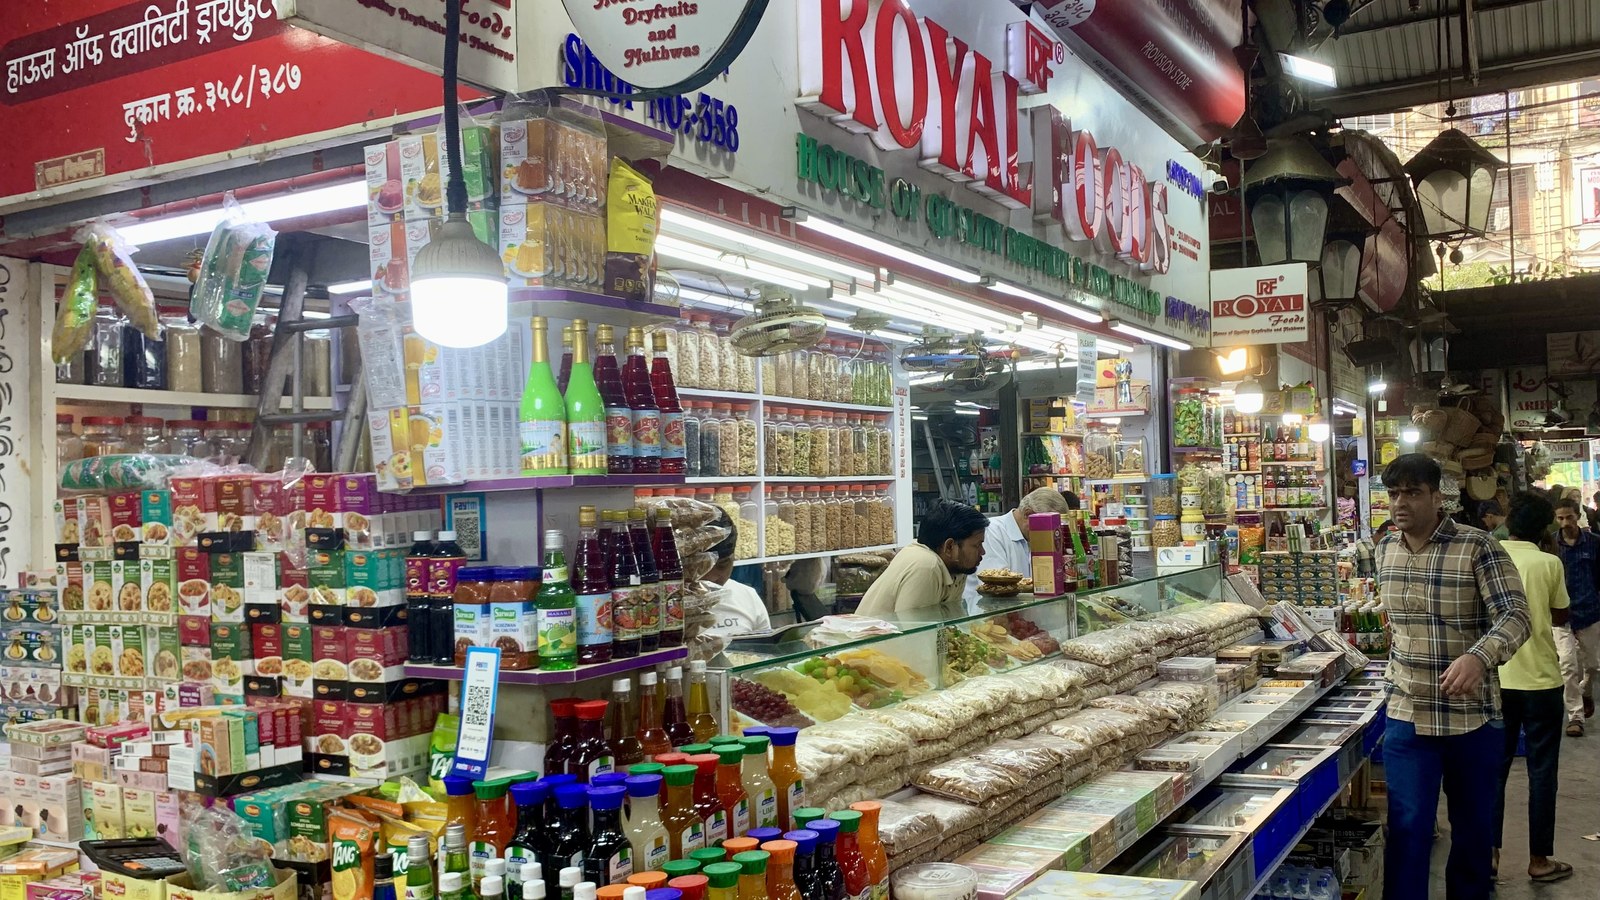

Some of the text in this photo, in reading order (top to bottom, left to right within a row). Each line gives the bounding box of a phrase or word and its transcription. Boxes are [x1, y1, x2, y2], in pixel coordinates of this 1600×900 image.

[622, 1, 698, 25] Dryfruits
[648, 24, 676, 41] and
[6, 47, 56, 94] हाऊस
[61, 24, 104, 74] ऑफ
[109, 5, 190, 60] क्वालिटी
[624, 44, 700, 68] Mukhwas
[1140, 40, 1193, 91] PROVISION STORE
[123, 97, 171, 142] दुकान
[819, 0, 1171, 276] ROYAL FOODS
[796, 133, 886, 210] HOUSE
[891, 177, 922, 223] OF
[1218, 295, 1302, 317] ROYAL
[1269, 314, 1304, 327] Foods
[763, 805, 775, 815] LIME
[332, 841, 356, 867] TANG
